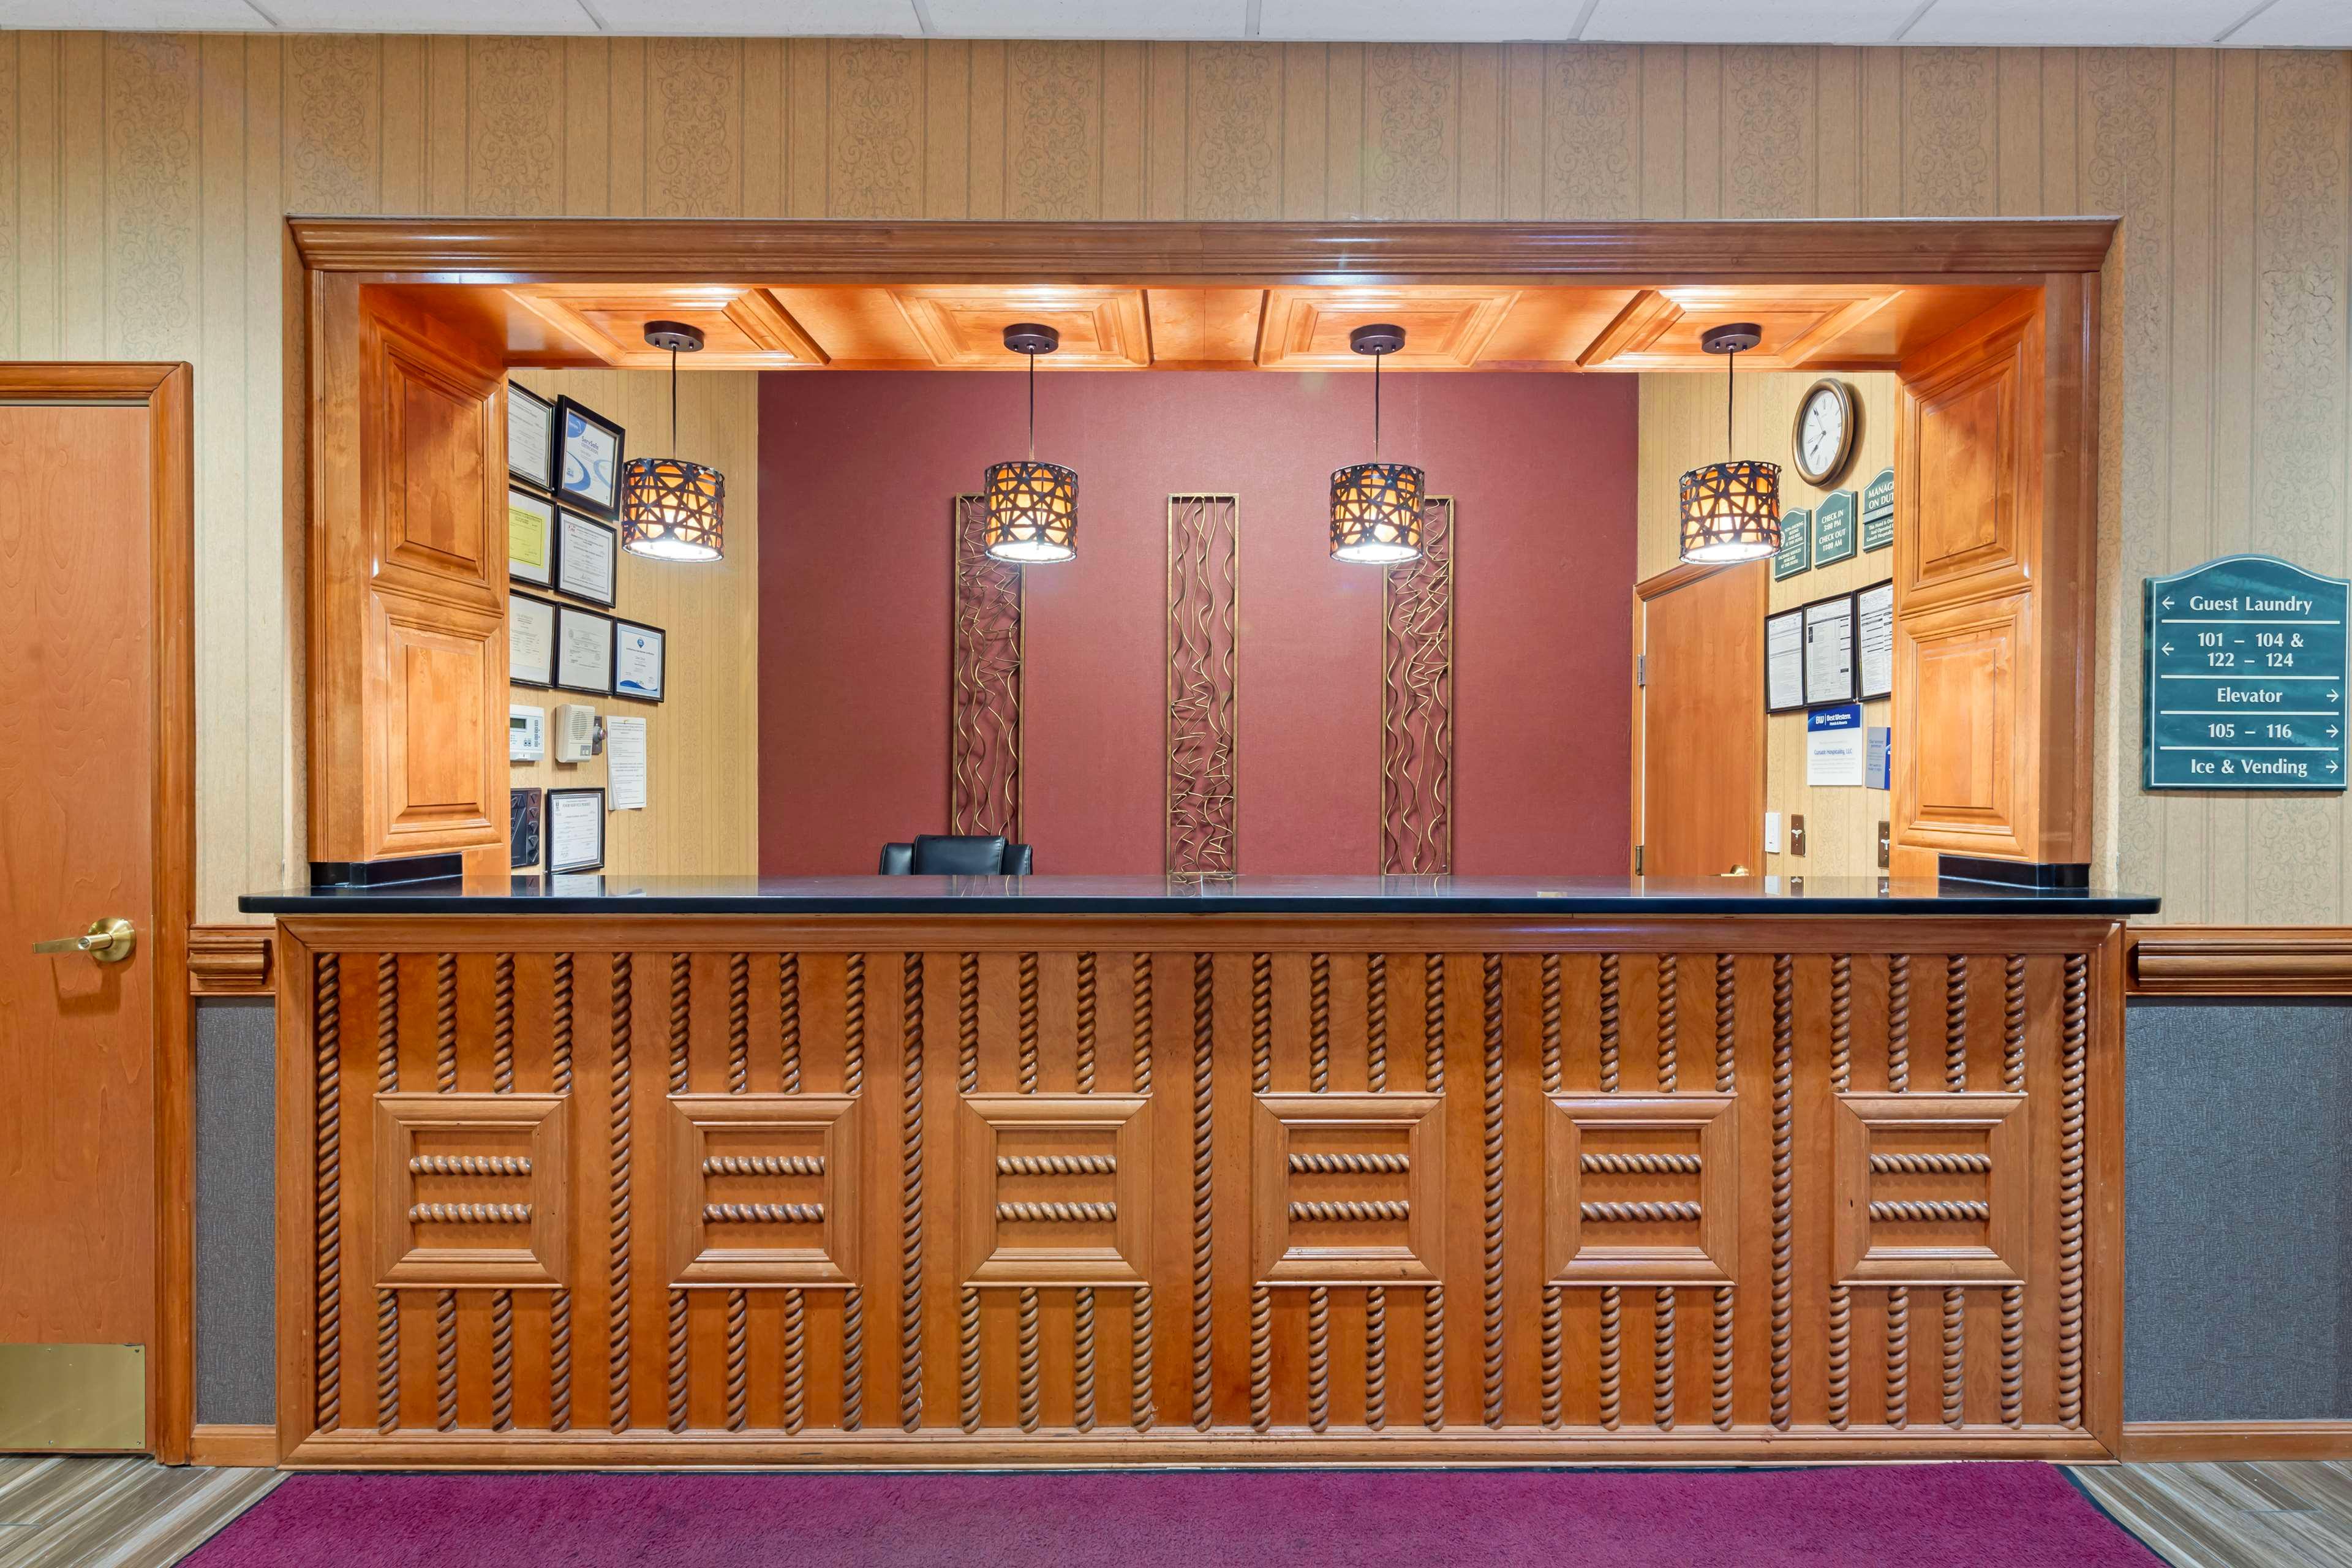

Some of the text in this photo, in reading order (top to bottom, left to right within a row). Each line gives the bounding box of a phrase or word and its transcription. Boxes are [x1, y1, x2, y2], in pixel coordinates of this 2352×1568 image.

[1868, 481, 1894, 499] MANAG
[1869, 492, 1894, 509] ON DUT
[1822, 512, 1838, 524] CHECK
[1819, 528, 1846, 544] CHECK OUT
[1823, 538, 1842, 551] 11:00 AM
[2190, 595, 2313, 615] Guest Laundry
[2198, 633, 2223, 647] 101
[2255, 633, 2283, 647] 104
[2290, 633, 2304, 647] &
[2207, 653, 2234, 667] 122
[2266, 653, 2294, 667] 124
[2217, 687, 2283, 703] Elevator
[1815, 715, 1825, 725] BW
[2208, 723, 2235, 738] 105
[2266, 724, 2292, 738] 116
[2191, 759, 2308, 777] Ice & Vending
